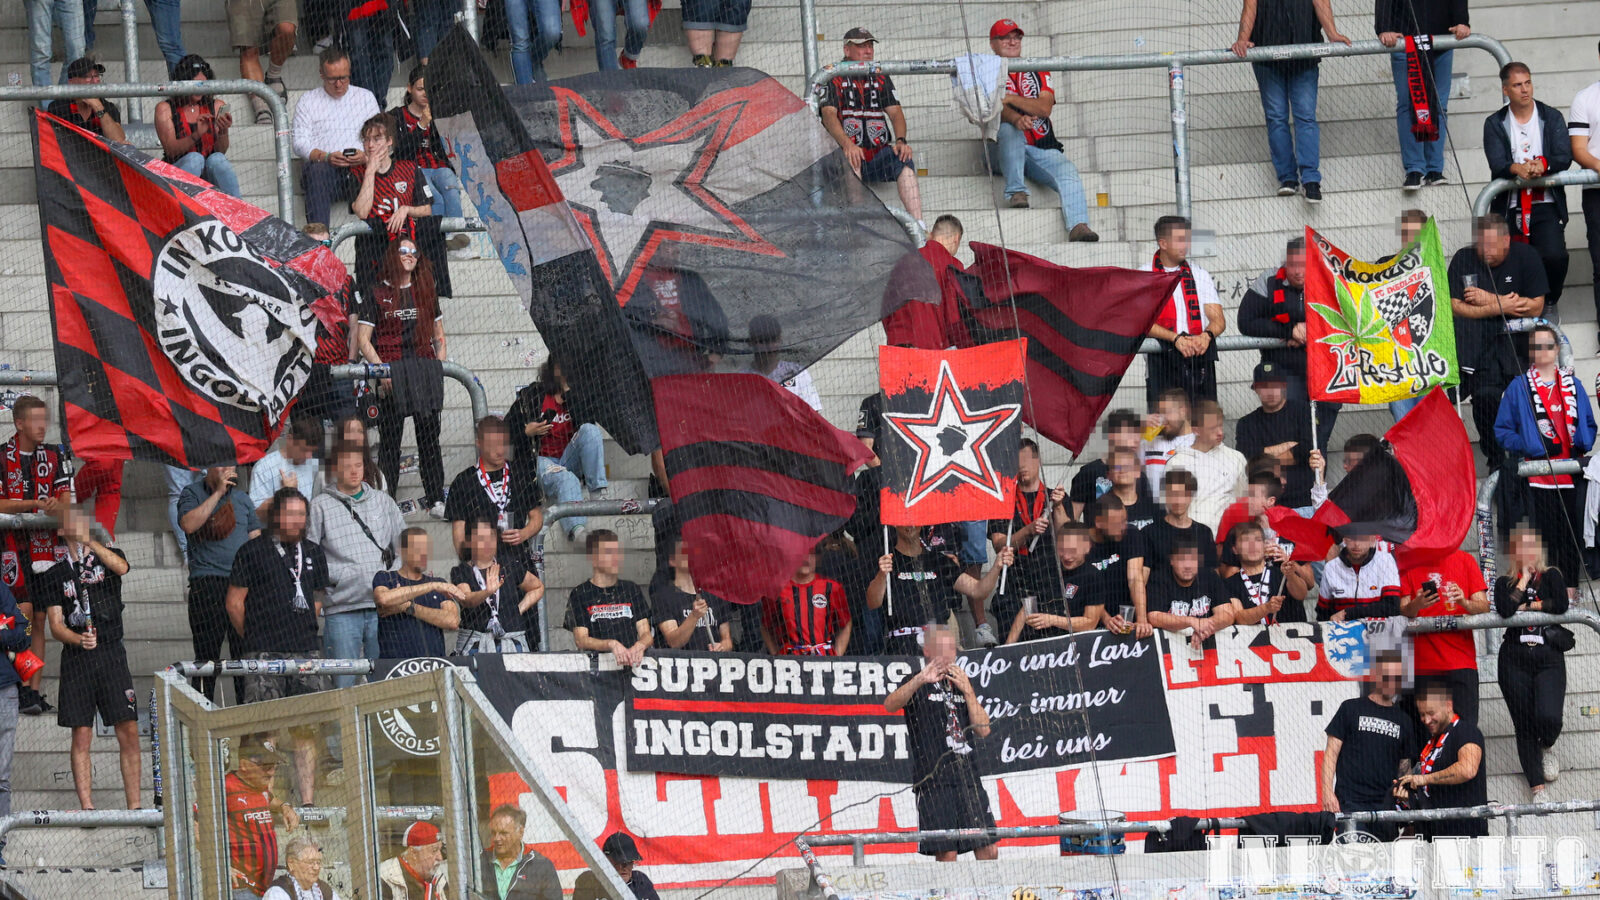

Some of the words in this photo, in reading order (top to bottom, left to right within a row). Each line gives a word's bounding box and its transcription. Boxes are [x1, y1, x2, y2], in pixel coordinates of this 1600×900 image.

[1406, 51, 1426, 105] SCHANZER
[214, 276, 283, 316] SCANZER
[1326, 343, 1448, 395] Lifestyle
[1020, 641, 1081, 672] und
[1089, 635, 1150, 668] Lars
[1164, 621, 1318, 685] FKS
[1030, 686, 1126, 714] immer
[633, 719, 910, 762] INGOLSTADT
[1001, 735, 1049, 764] bei
[1055, 732, 1112, 756] uns
